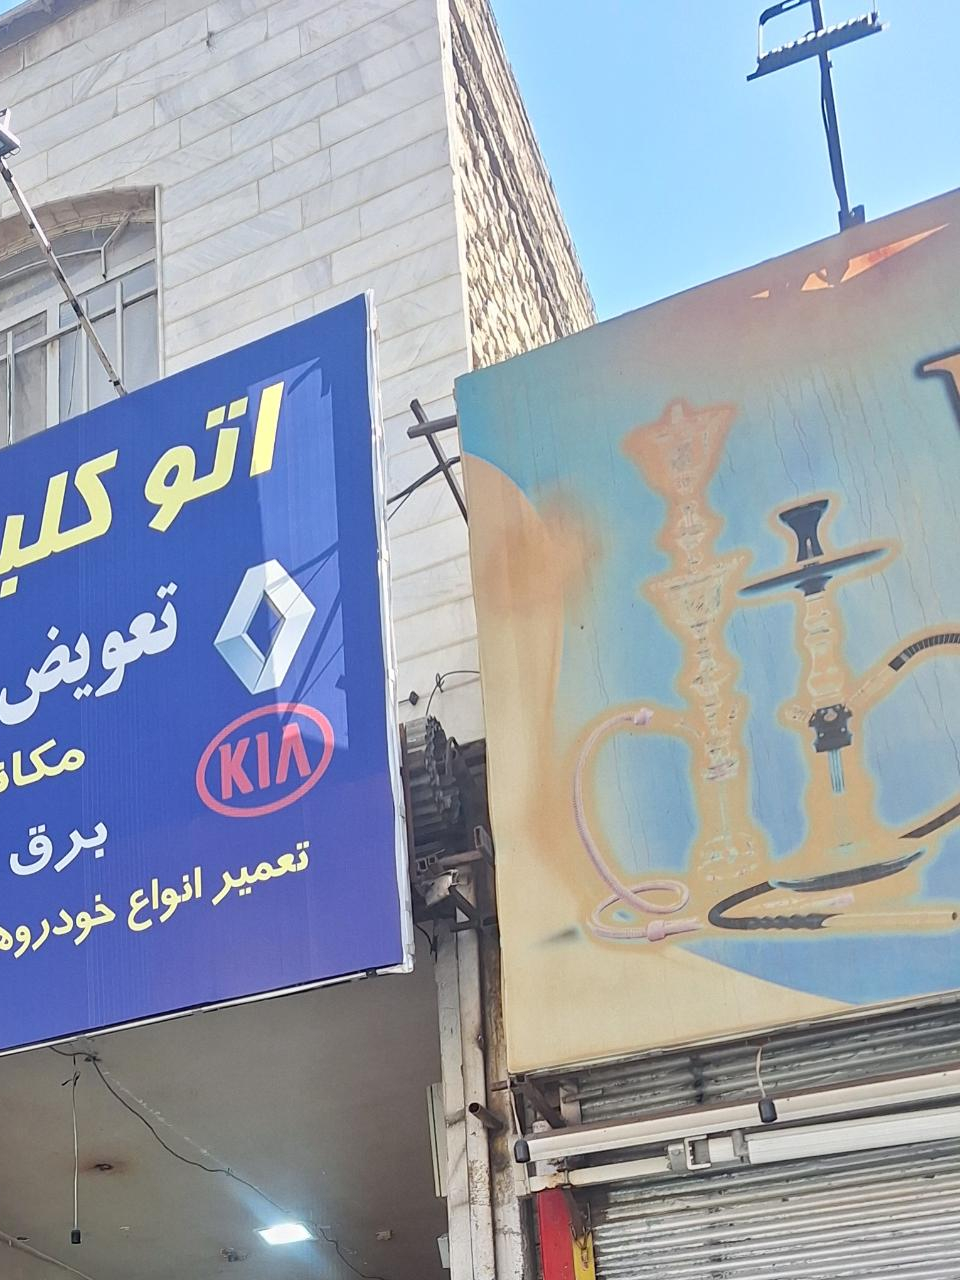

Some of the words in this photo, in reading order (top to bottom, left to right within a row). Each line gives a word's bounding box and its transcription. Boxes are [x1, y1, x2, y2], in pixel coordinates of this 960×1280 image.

[144, 381, 285, 532] اتو
[218, 721, 312, 801] KIA
[9, 820, 109, 876] برق
[212, 841, 310, 905] تعمیر
[127, 867, 202, 932] انواع
